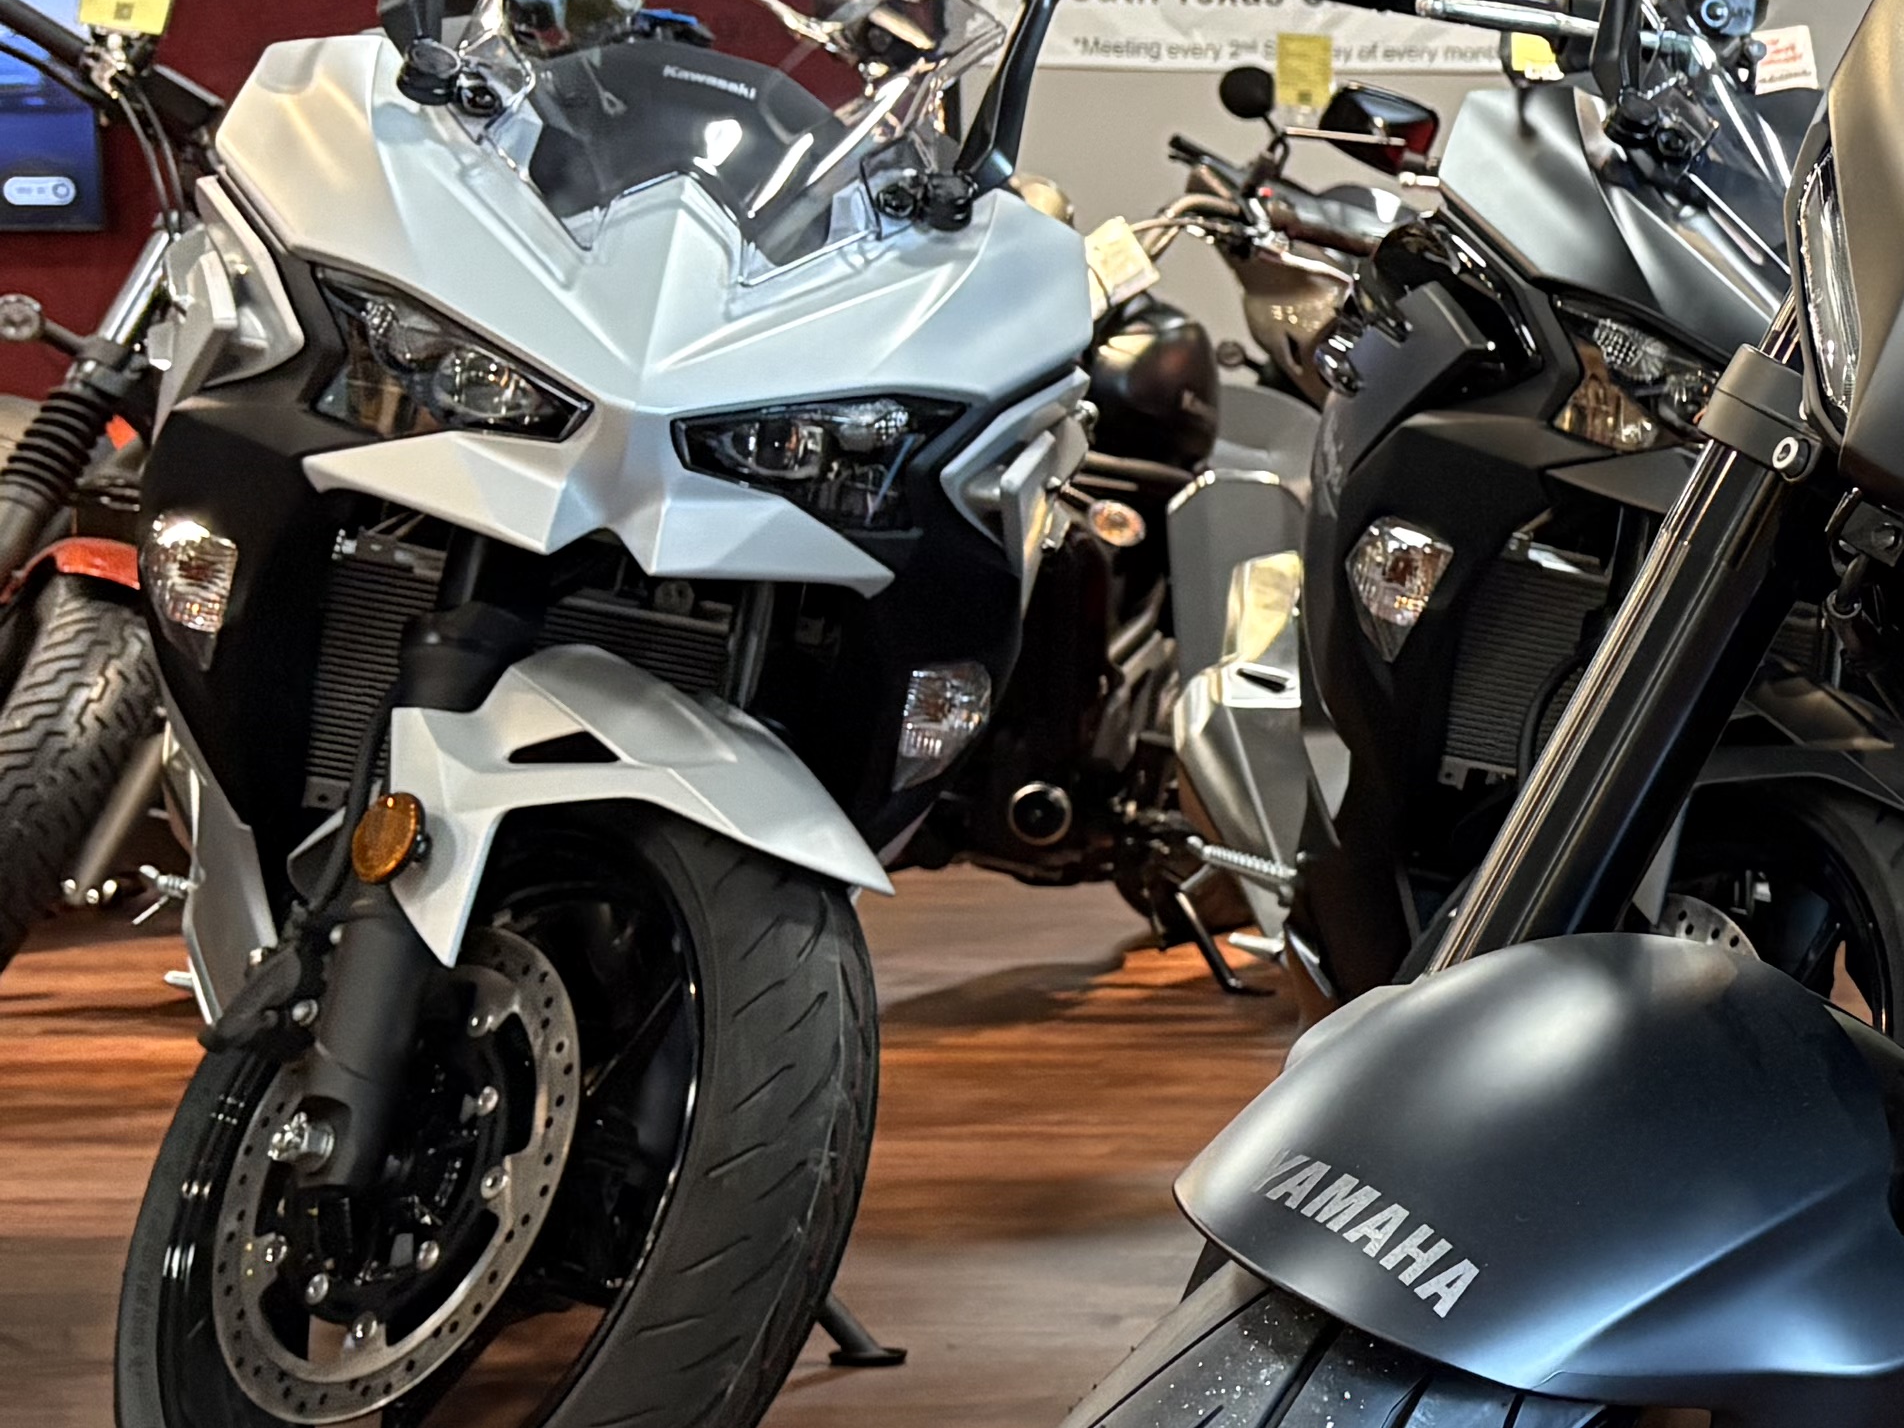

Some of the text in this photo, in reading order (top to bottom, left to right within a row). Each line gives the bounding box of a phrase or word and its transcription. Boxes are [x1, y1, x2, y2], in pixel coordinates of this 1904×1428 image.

[1167, 43, 1222, 63] every
[1357, 43, 1379, 62] of
[1382, 46, 1438, 66] every
[1443, 45, 1504, 64] mont
[662, 63, 758, 102] Kawasaki
[1252, 1147, 1481, 1319] YAMAHA
